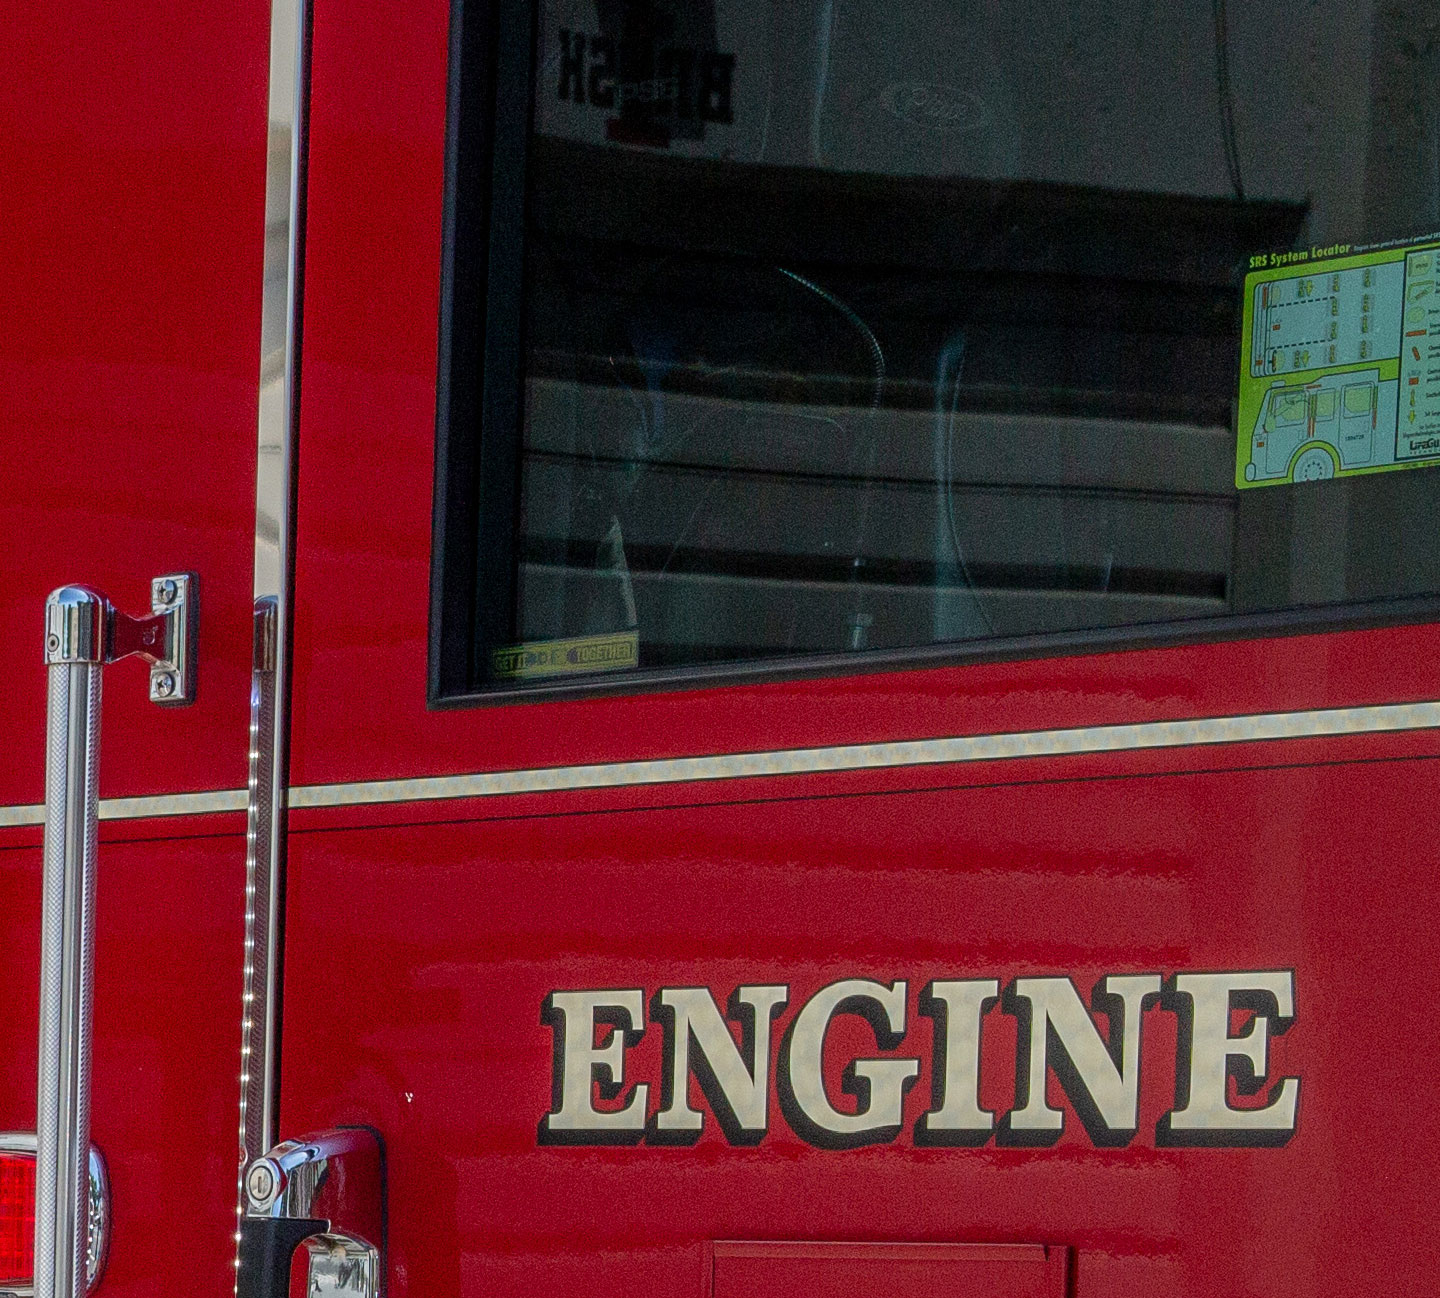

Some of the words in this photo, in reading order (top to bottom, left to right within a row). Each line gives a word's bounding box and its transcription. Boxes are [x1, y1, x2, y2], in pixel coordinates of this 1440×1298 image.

[1249, 254, 1268, 269] SRS
[1270, 250, 1309, 267] System
[1311, 243, 1351, 259] Locator
[537, 970, 1301, 1149] ENGINE
